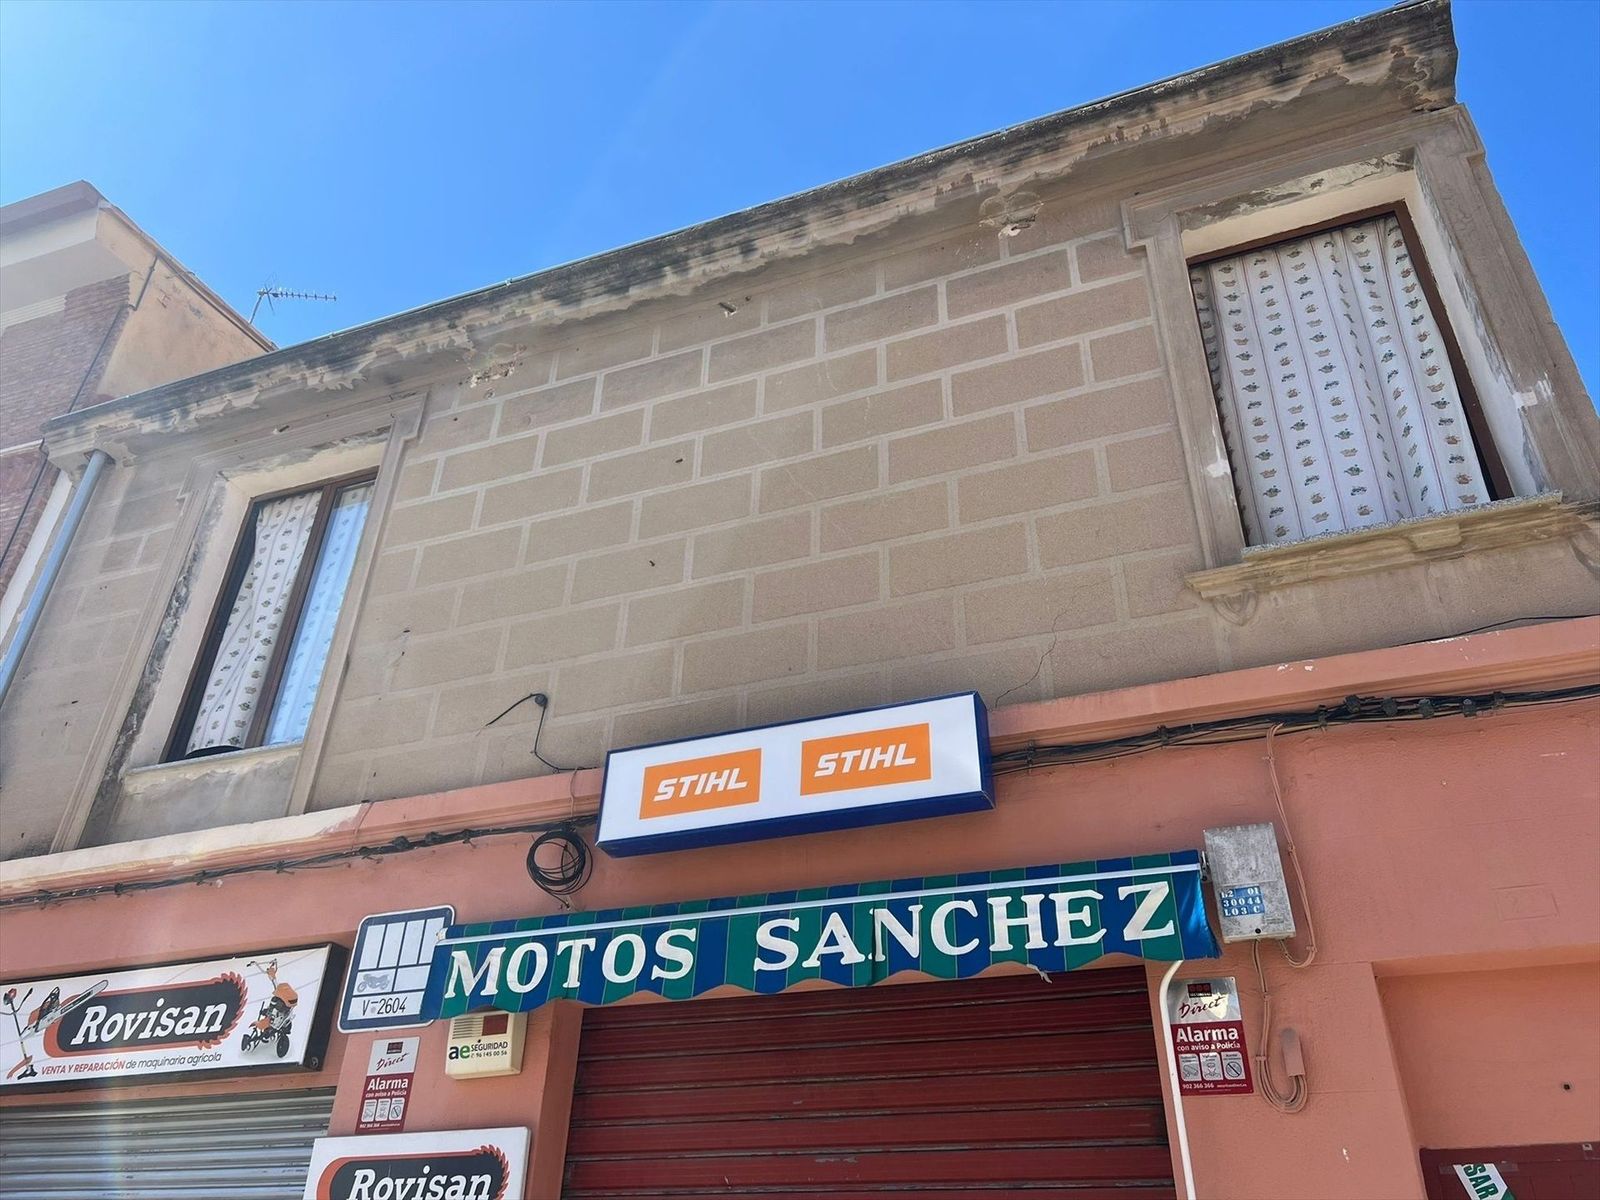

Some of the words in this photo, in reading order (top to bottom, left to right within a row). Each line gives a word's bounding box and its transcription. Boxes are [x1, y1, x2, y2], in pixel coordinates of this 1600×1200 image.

[813, 743, 916, 778] STIHL
[652, 767, 748, 802] STIHL
[444, 927, 697, 999] MOTOS
[754, 880, 1175, 972] SANCHEZ
[1179, 995, 1226, 1019] Direct
[70, 998, 228, 1047] Rovisan
[1176, 1026, 1239, 1043] Alarma
[448, 1045, 471, 1060] ae
[470, 1041, 509, 1052] SEGURIDAD
[1190, 1043, 1210, 1051] aviso
[1216, 1040, 1241, 1050] Policía
[41, 1066, 66, 1076] VENTA
[67, 1064, 74, 1074] Y
[74, 1058, 126, 1073] REPARACIÓN
[125, 1059, 137, 1069] de
[137, 1056, 186, 1069] maquinaria
[186, 1052, 222, 1067] agrícola
[376, 1052, 410, 1071] Direct
[367, 1077, 409, 1091] Alarma
[346, 1165, 492, 1200] Rovisan
